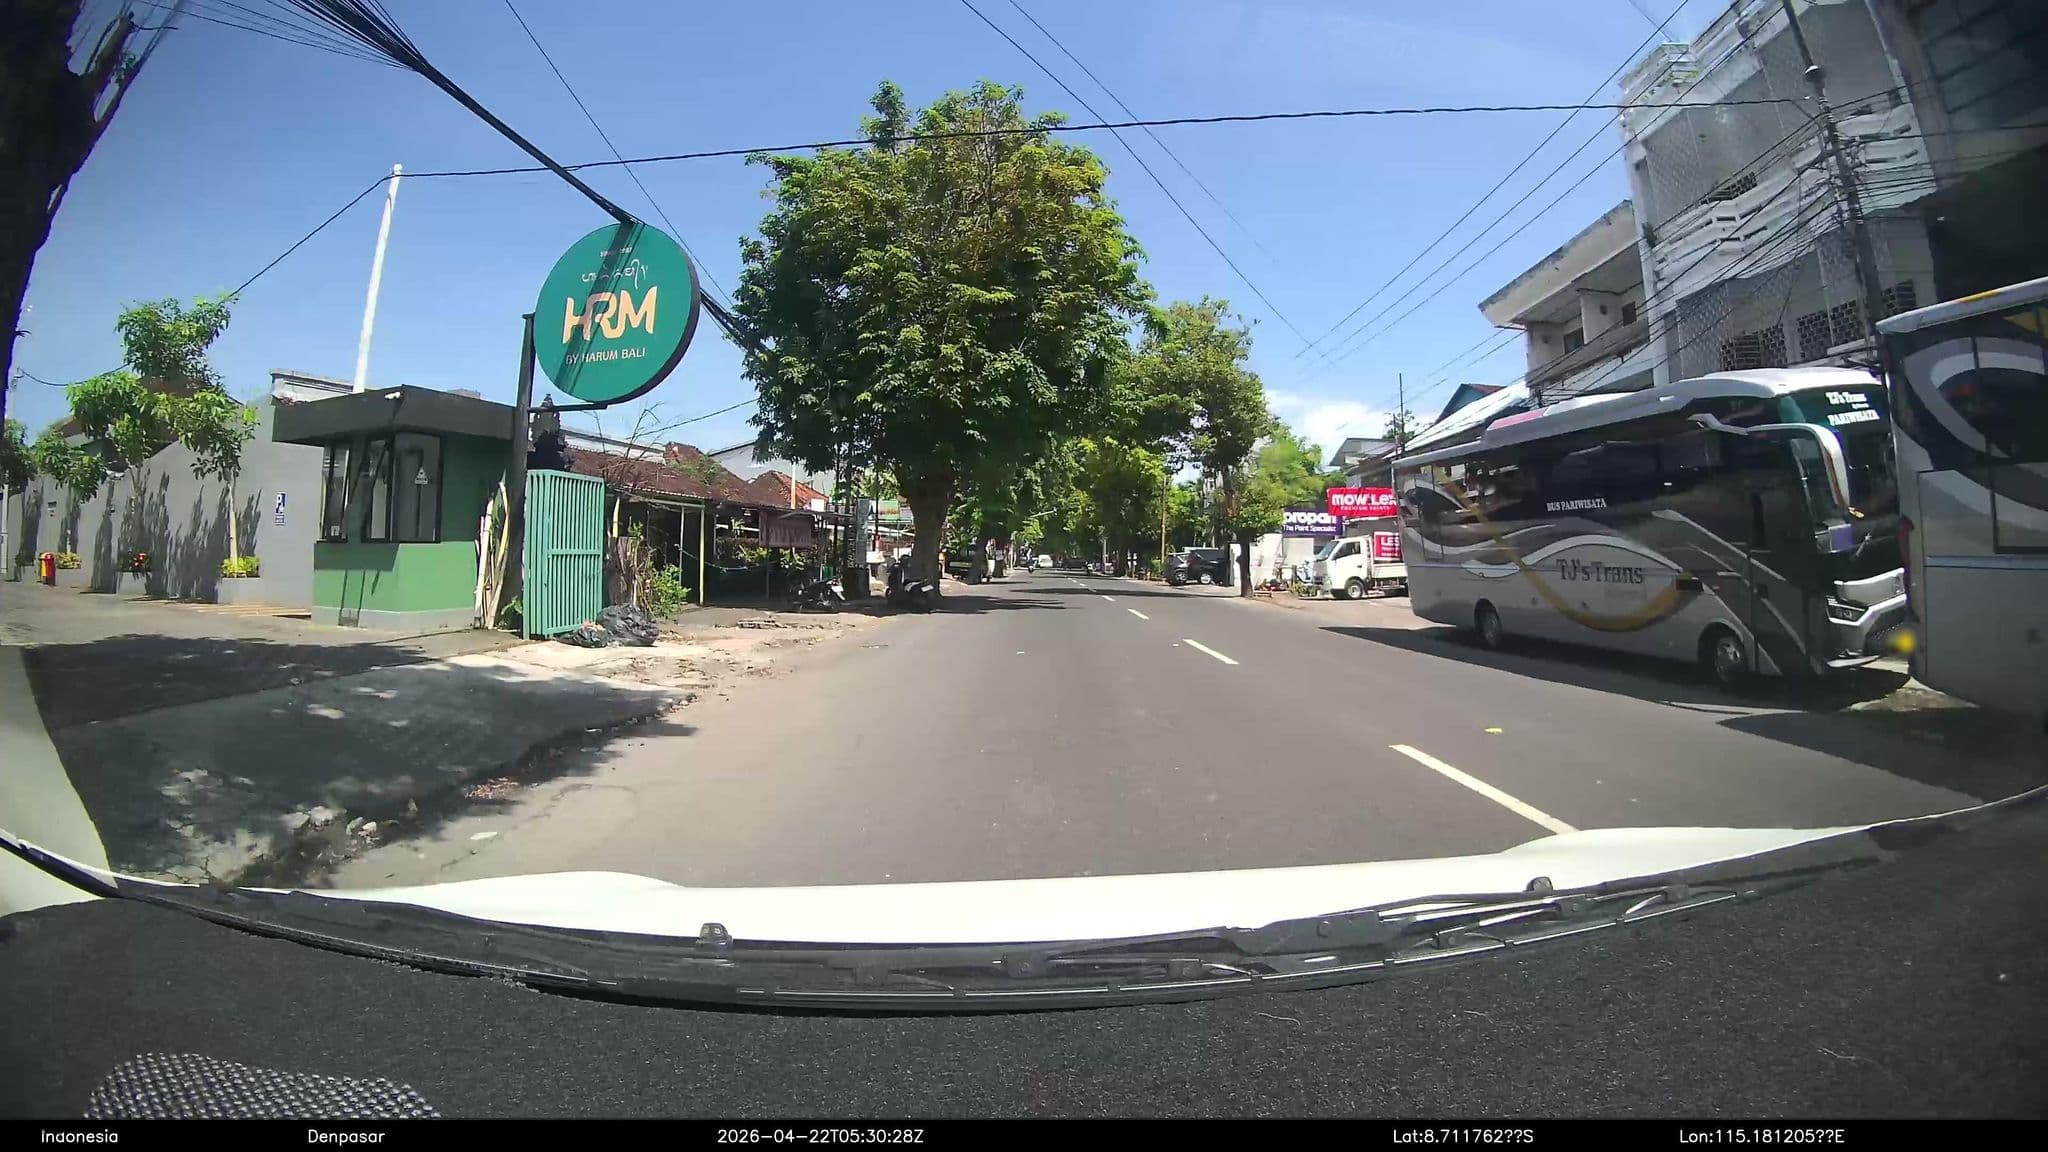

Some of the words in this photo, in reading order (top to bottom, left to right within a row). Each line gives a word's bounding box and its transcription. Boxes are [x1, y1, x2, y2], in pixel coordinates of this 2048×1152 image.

[562, 286, 657, 344] HRM
[566, 353, 579, 364] BY
[581, 350, 618, 363] HARUM
[621, 347, 646, 359] BALI
[1547, 501, 1561, 512] BUS
[1560, 498, 1607, 510] PARIWISATA
[1556, 559, 1590, 581] TJ's
[1591, 562, 1643, 584] Trans
